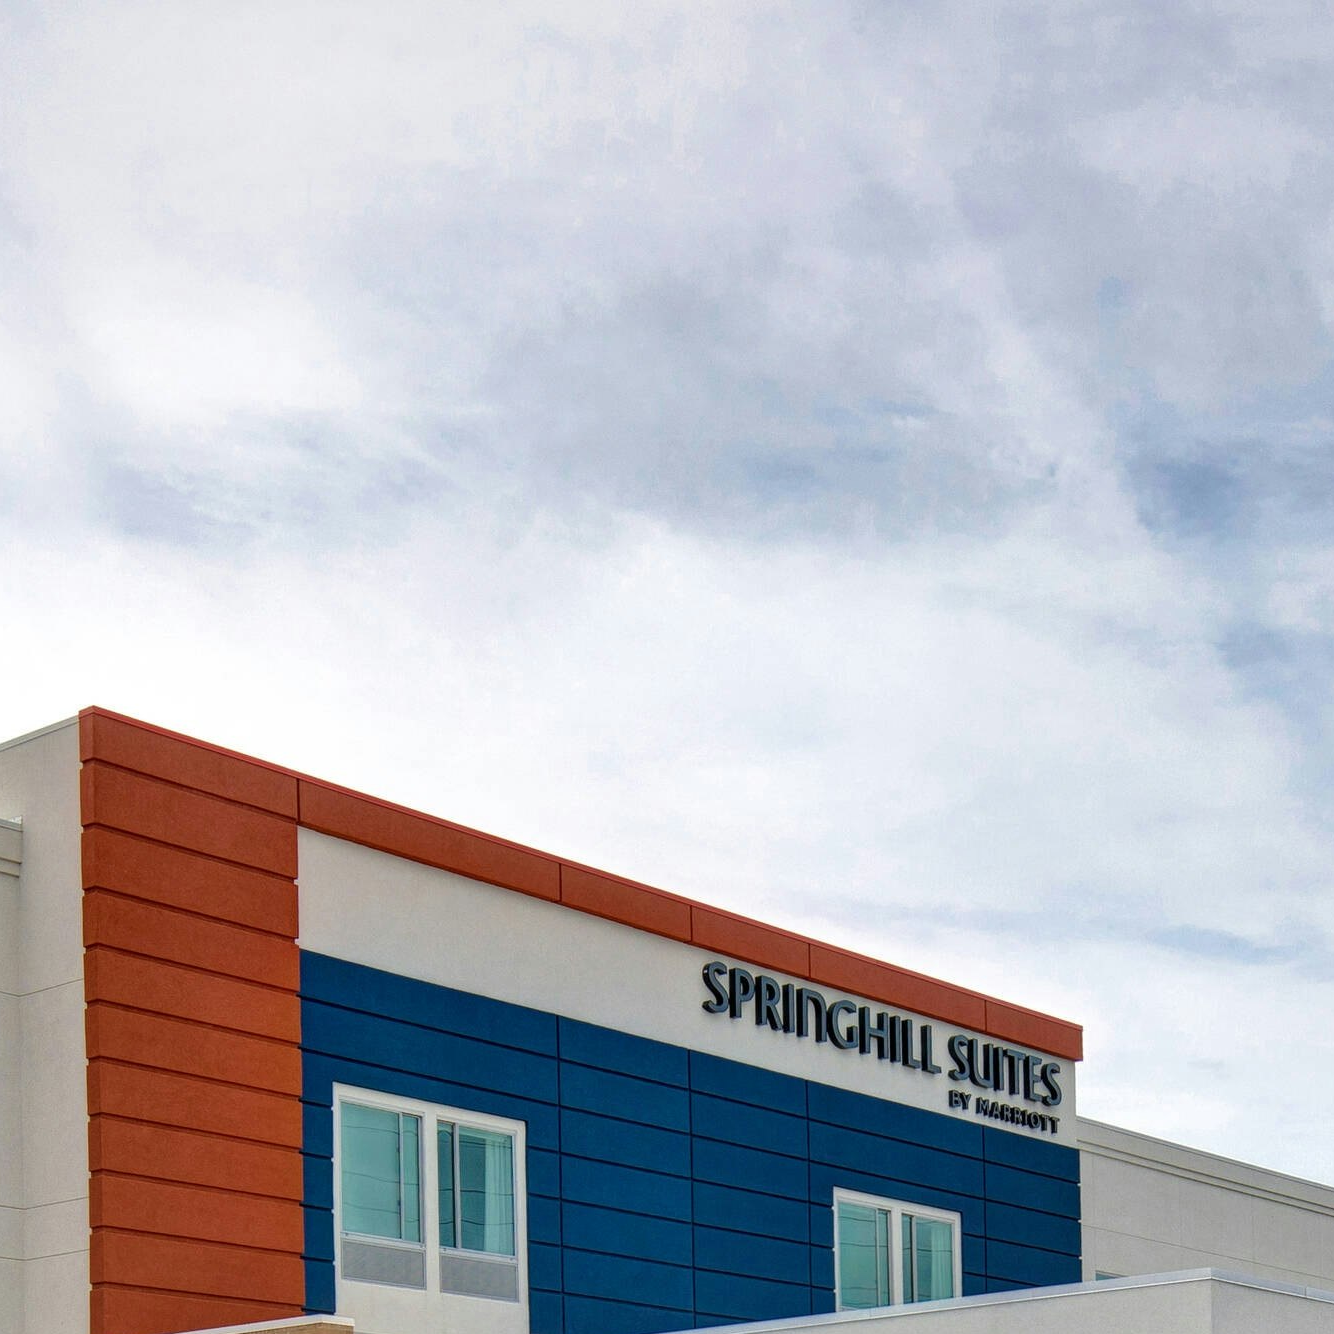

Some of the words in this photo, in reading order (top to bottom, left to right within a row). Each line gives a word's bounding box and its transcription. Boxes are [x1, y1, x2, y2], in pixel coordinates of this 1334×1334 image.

[702, 961, 942, 1075] SPRINGHILL
[948, 1033, 1062, 1107] SUITES
[948, 1089, 972, 1111] BY
[976, 1097, 1060, 1134] MARRIOTT
